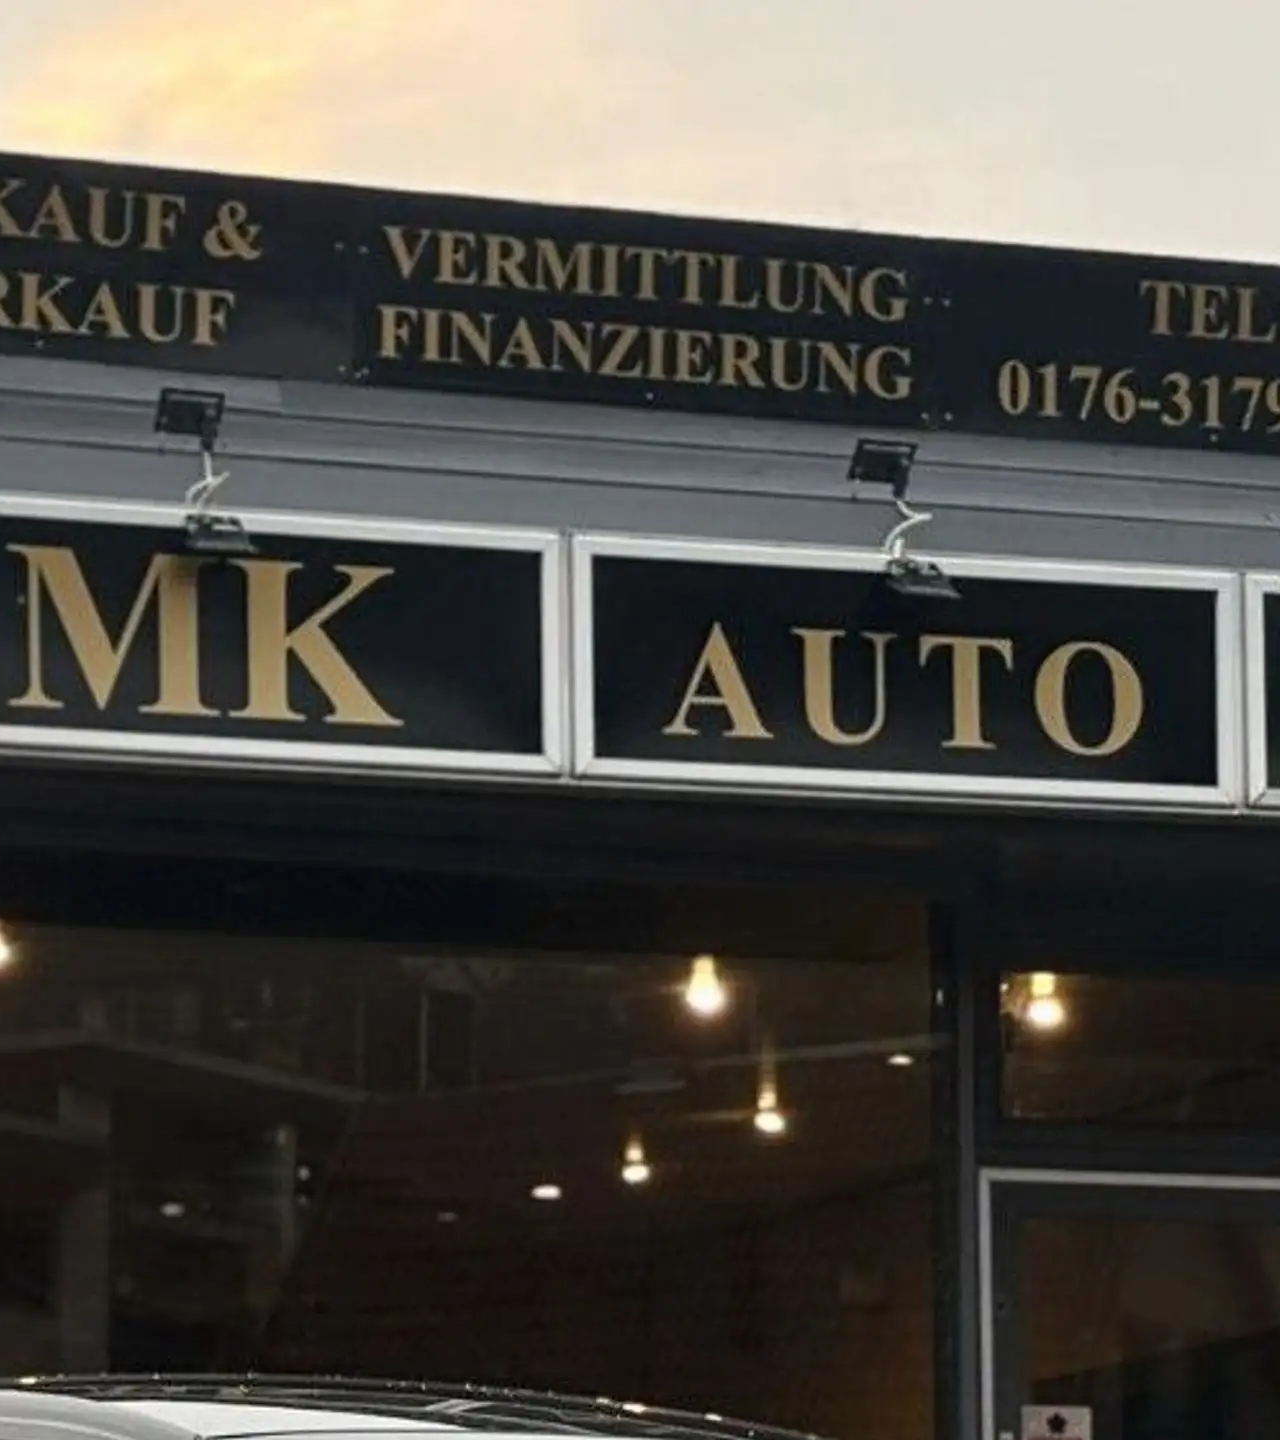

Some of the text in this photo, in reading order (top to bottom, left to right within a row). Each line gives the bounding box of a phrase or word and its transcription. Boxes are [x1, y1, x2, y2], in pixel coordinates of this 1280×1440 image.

[203, 199, 263, 261] &
[382, 225, 910, 323] VERMITTLUNG
[377, 304, 915, 400] FINANZIERUNG
[7, 543, 404, 726] MK
[662, 621, 1143, 757] AUTO
